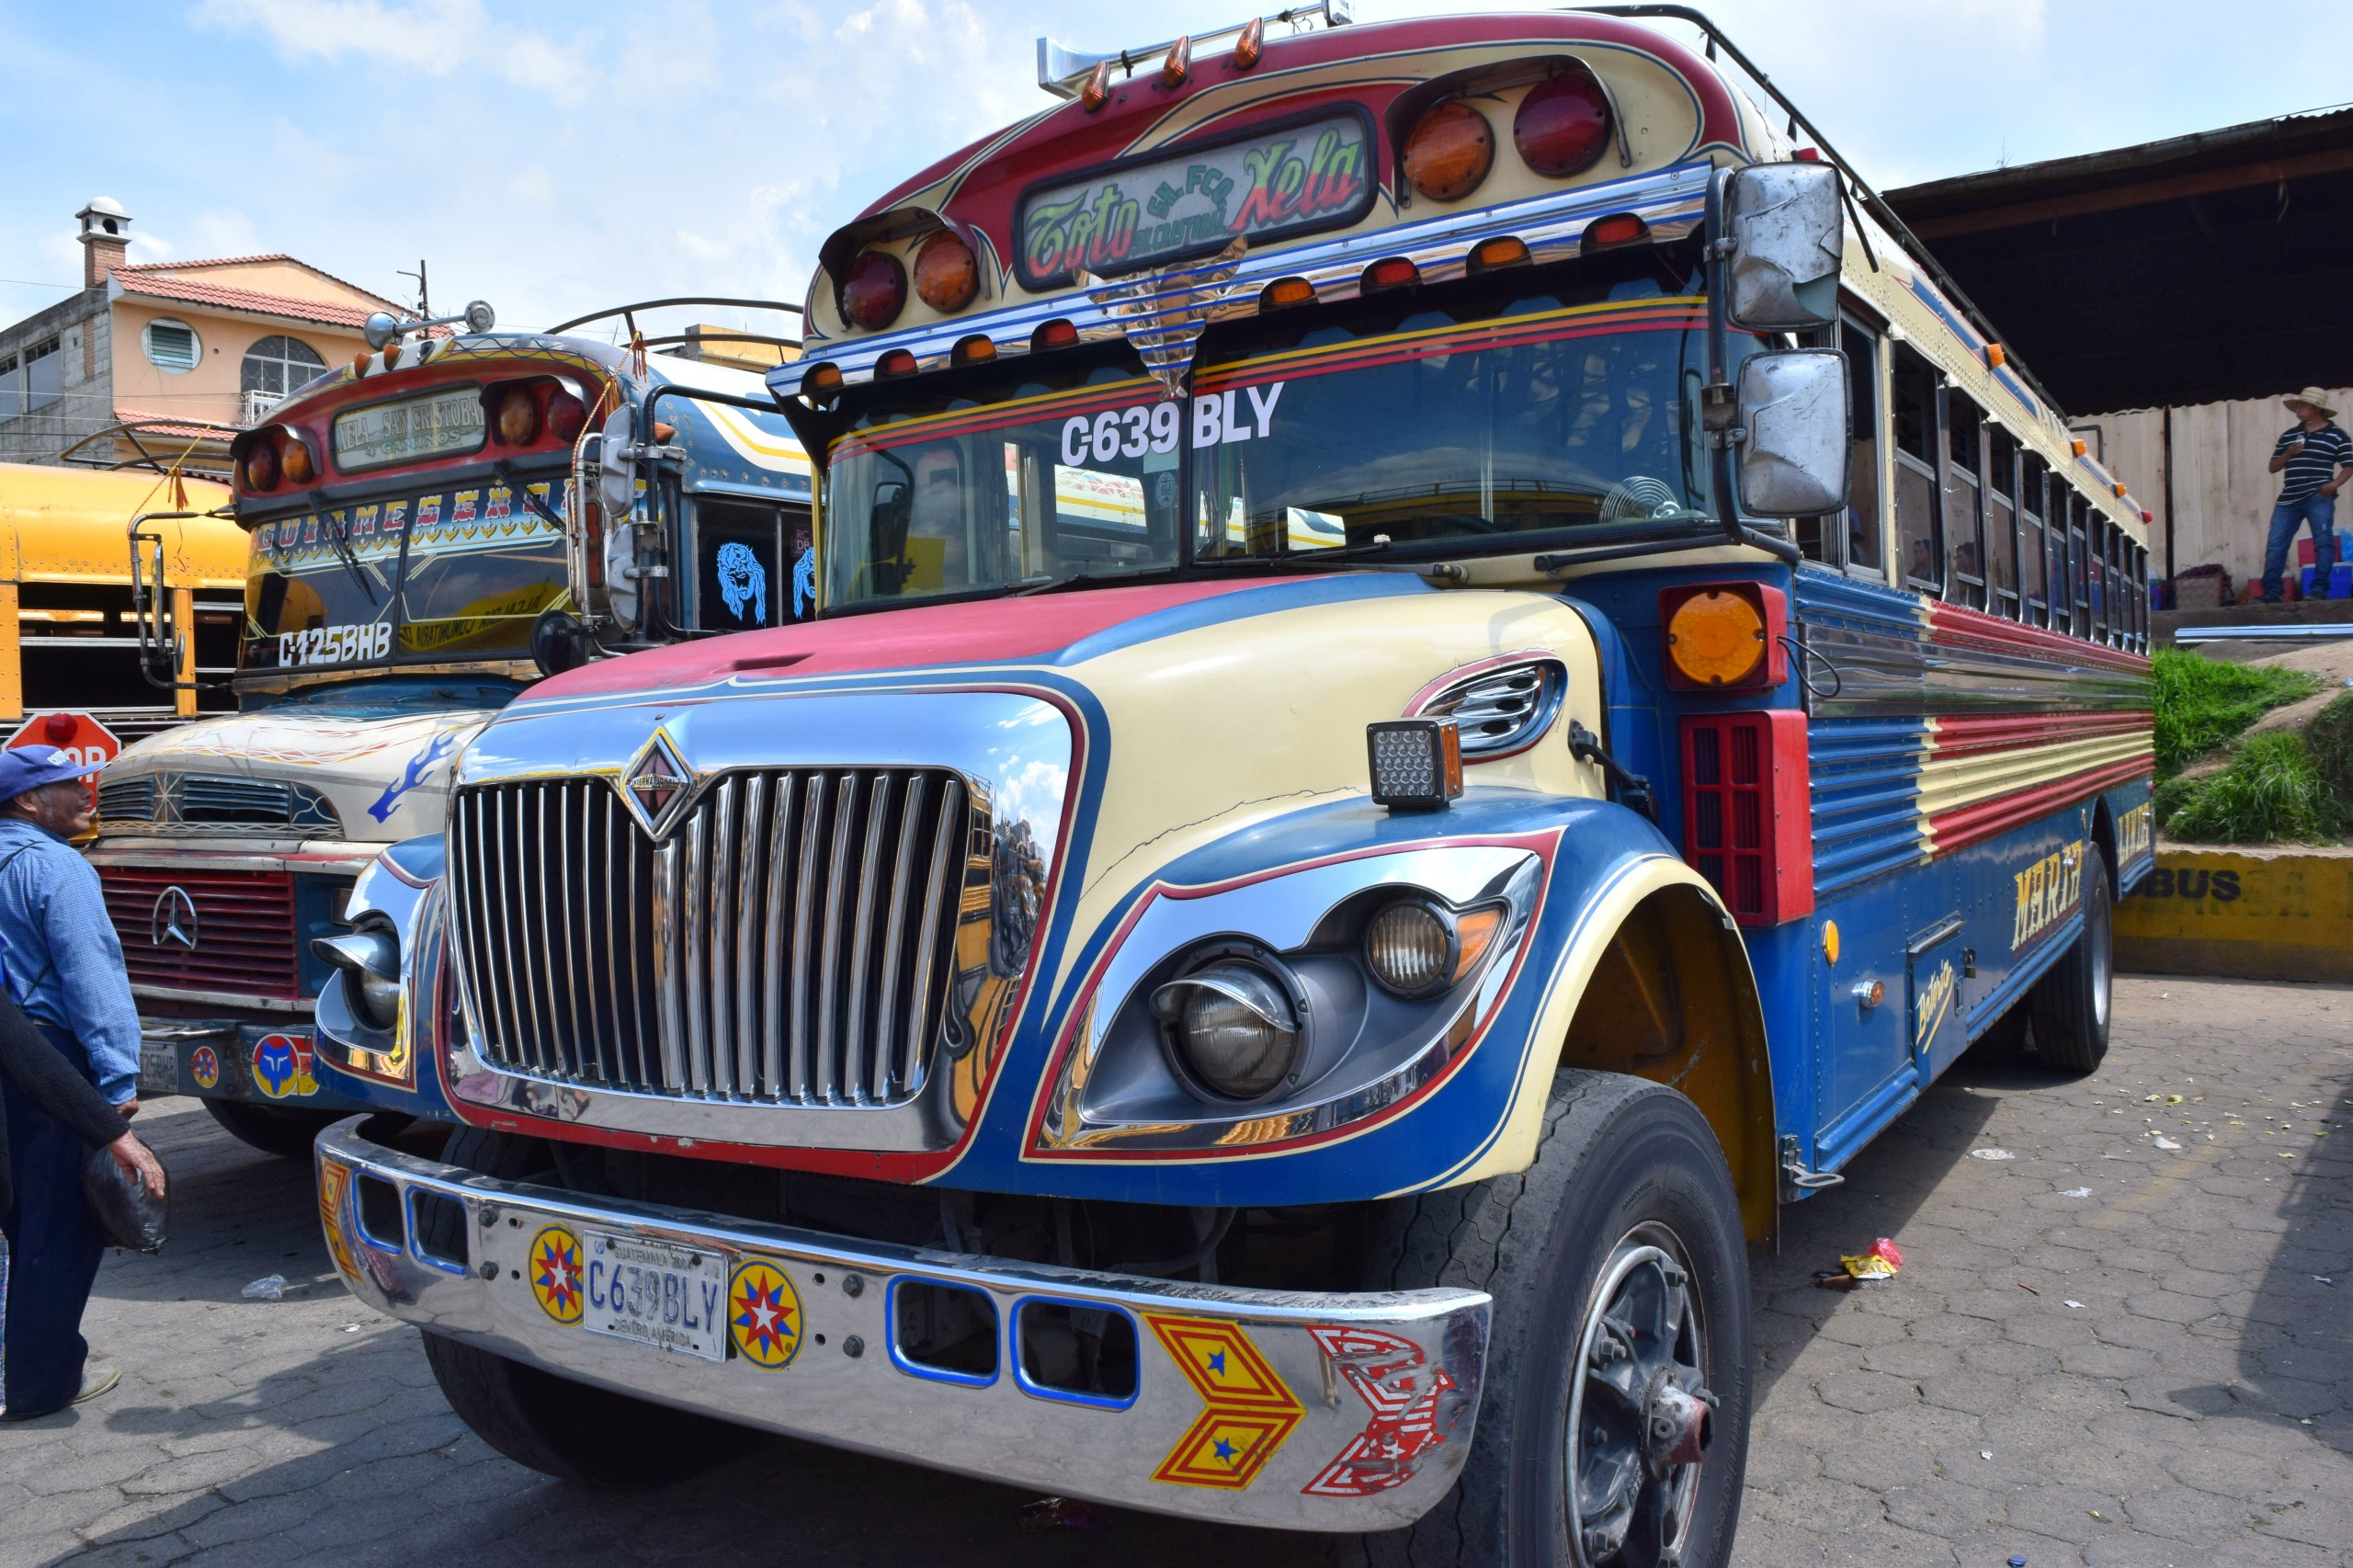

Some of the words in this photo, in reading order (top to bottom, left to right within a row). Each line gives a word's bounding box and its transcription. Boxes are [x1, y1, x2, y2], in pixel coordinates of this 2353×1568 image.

[1026, 183, 1141, 279] Toto
[1228, 127, 1367, 235] Xela
[337, 417, 370, 453] XELA
[382, 408, 408, 437] SAN
[1062, 401, 1180, 467] C-639
[1192, 381, 1285, 449] BLY
[365, 446, 377, 458] 4
[63, 745, 107, 783] OP
[2010, 839, 2084, 951] MARIA
[2130, 868, 2241, 902] BUS
[614, 1244, 669, 1267] GUATEMALA
[589, 1258, 719, 1334] C639BLY
